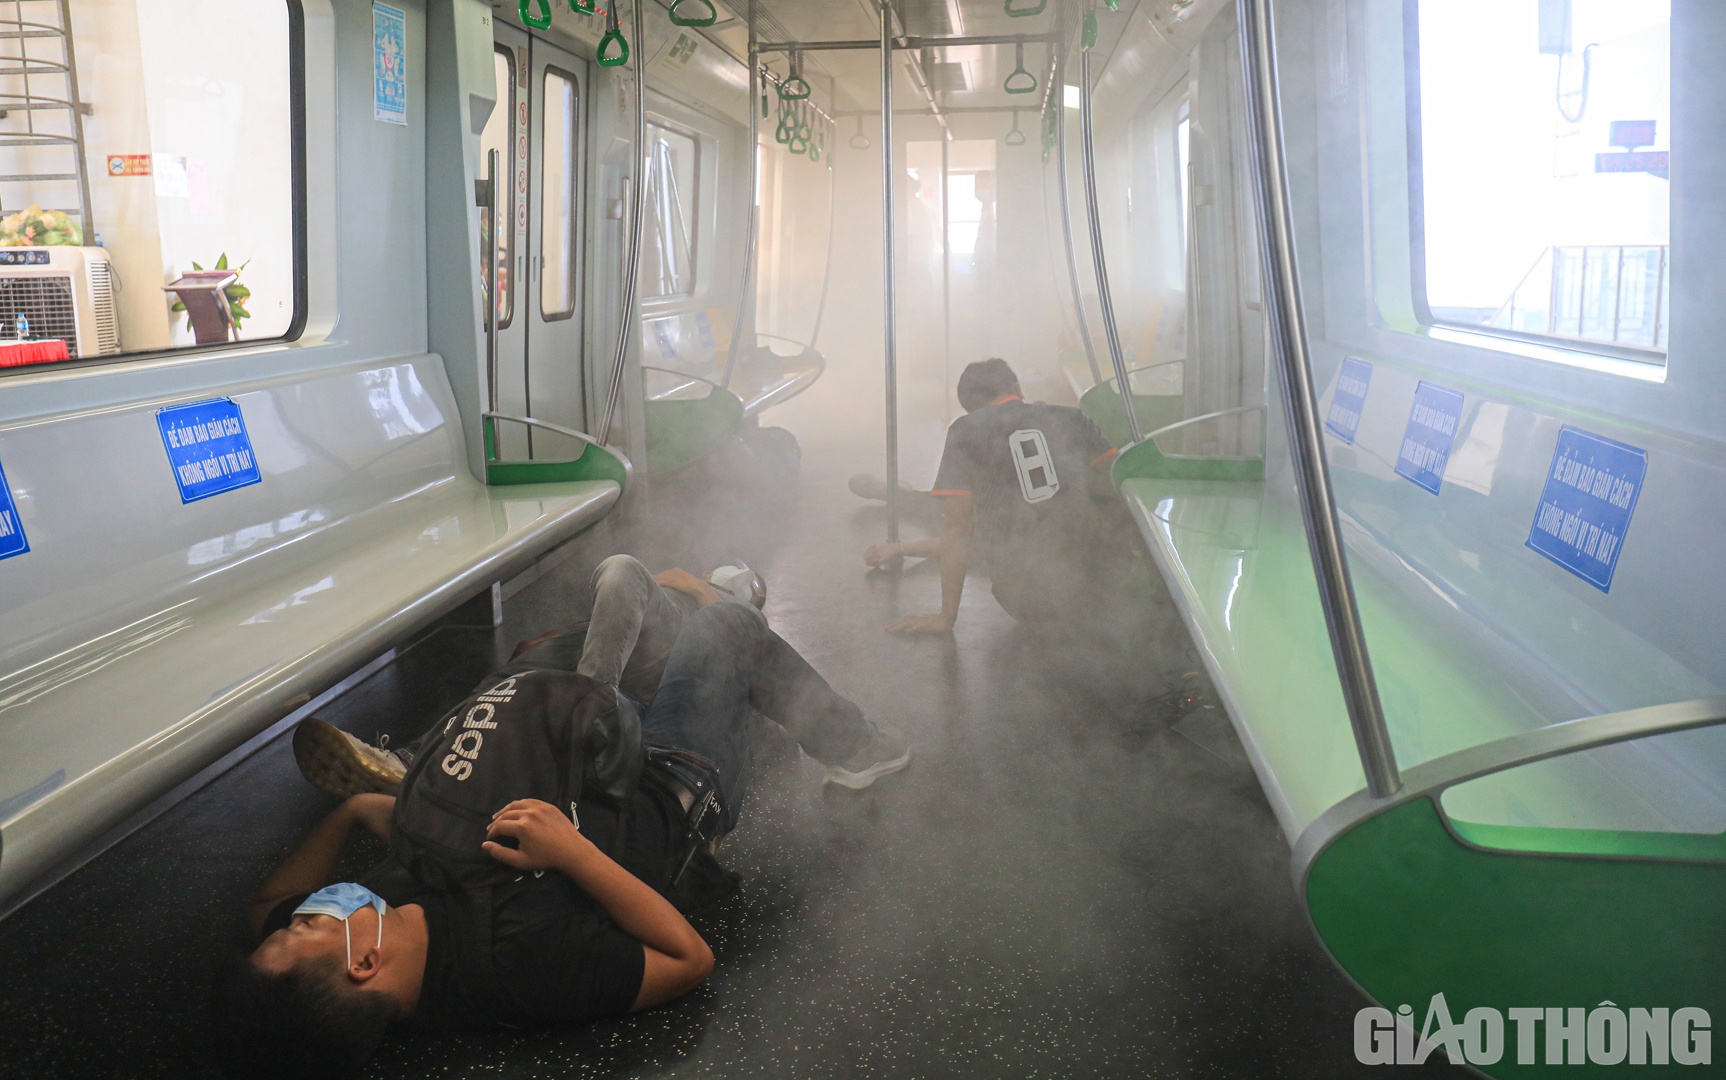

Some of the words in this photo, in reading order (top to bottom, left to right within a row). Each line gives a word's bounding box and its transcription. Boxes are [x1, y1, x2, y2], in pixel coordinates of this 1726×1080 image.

[167, 421, 180, 448] ĐỂ
[177, 419, 196, 446] ĐẢM
[193, 416, 210, 442] BẢO
[207, 417, 225, 440] GIÃN
[222, 414, 241, 436] CÁCH
[177, 460, 206, 486] KHÔNG
[218, 455, 231, 478] VỊ
[226, 448, 240, 473] TRÍ
[237, 446, 253, 471] NÀY
[1009, 429, 1060, 503] 8
[1553, 448, 1570, 481] ĐỂ
[1562, 450, 1582, 487] ĐẢM
[1577, 456, 1595, 494] BẢO
[1591, 468, 1614, 501] GIÃN
[1609, 474, 1635, 510] CÁCH
[1536, 500, 1564, 537] KHÔNG
[1576, 520, 1589, 557] VỊ
[1584, 522, 1604, 557] TRÍ
[1595, 527, 1618, 566] NÀY
[441, 669, 537, 781] didas
